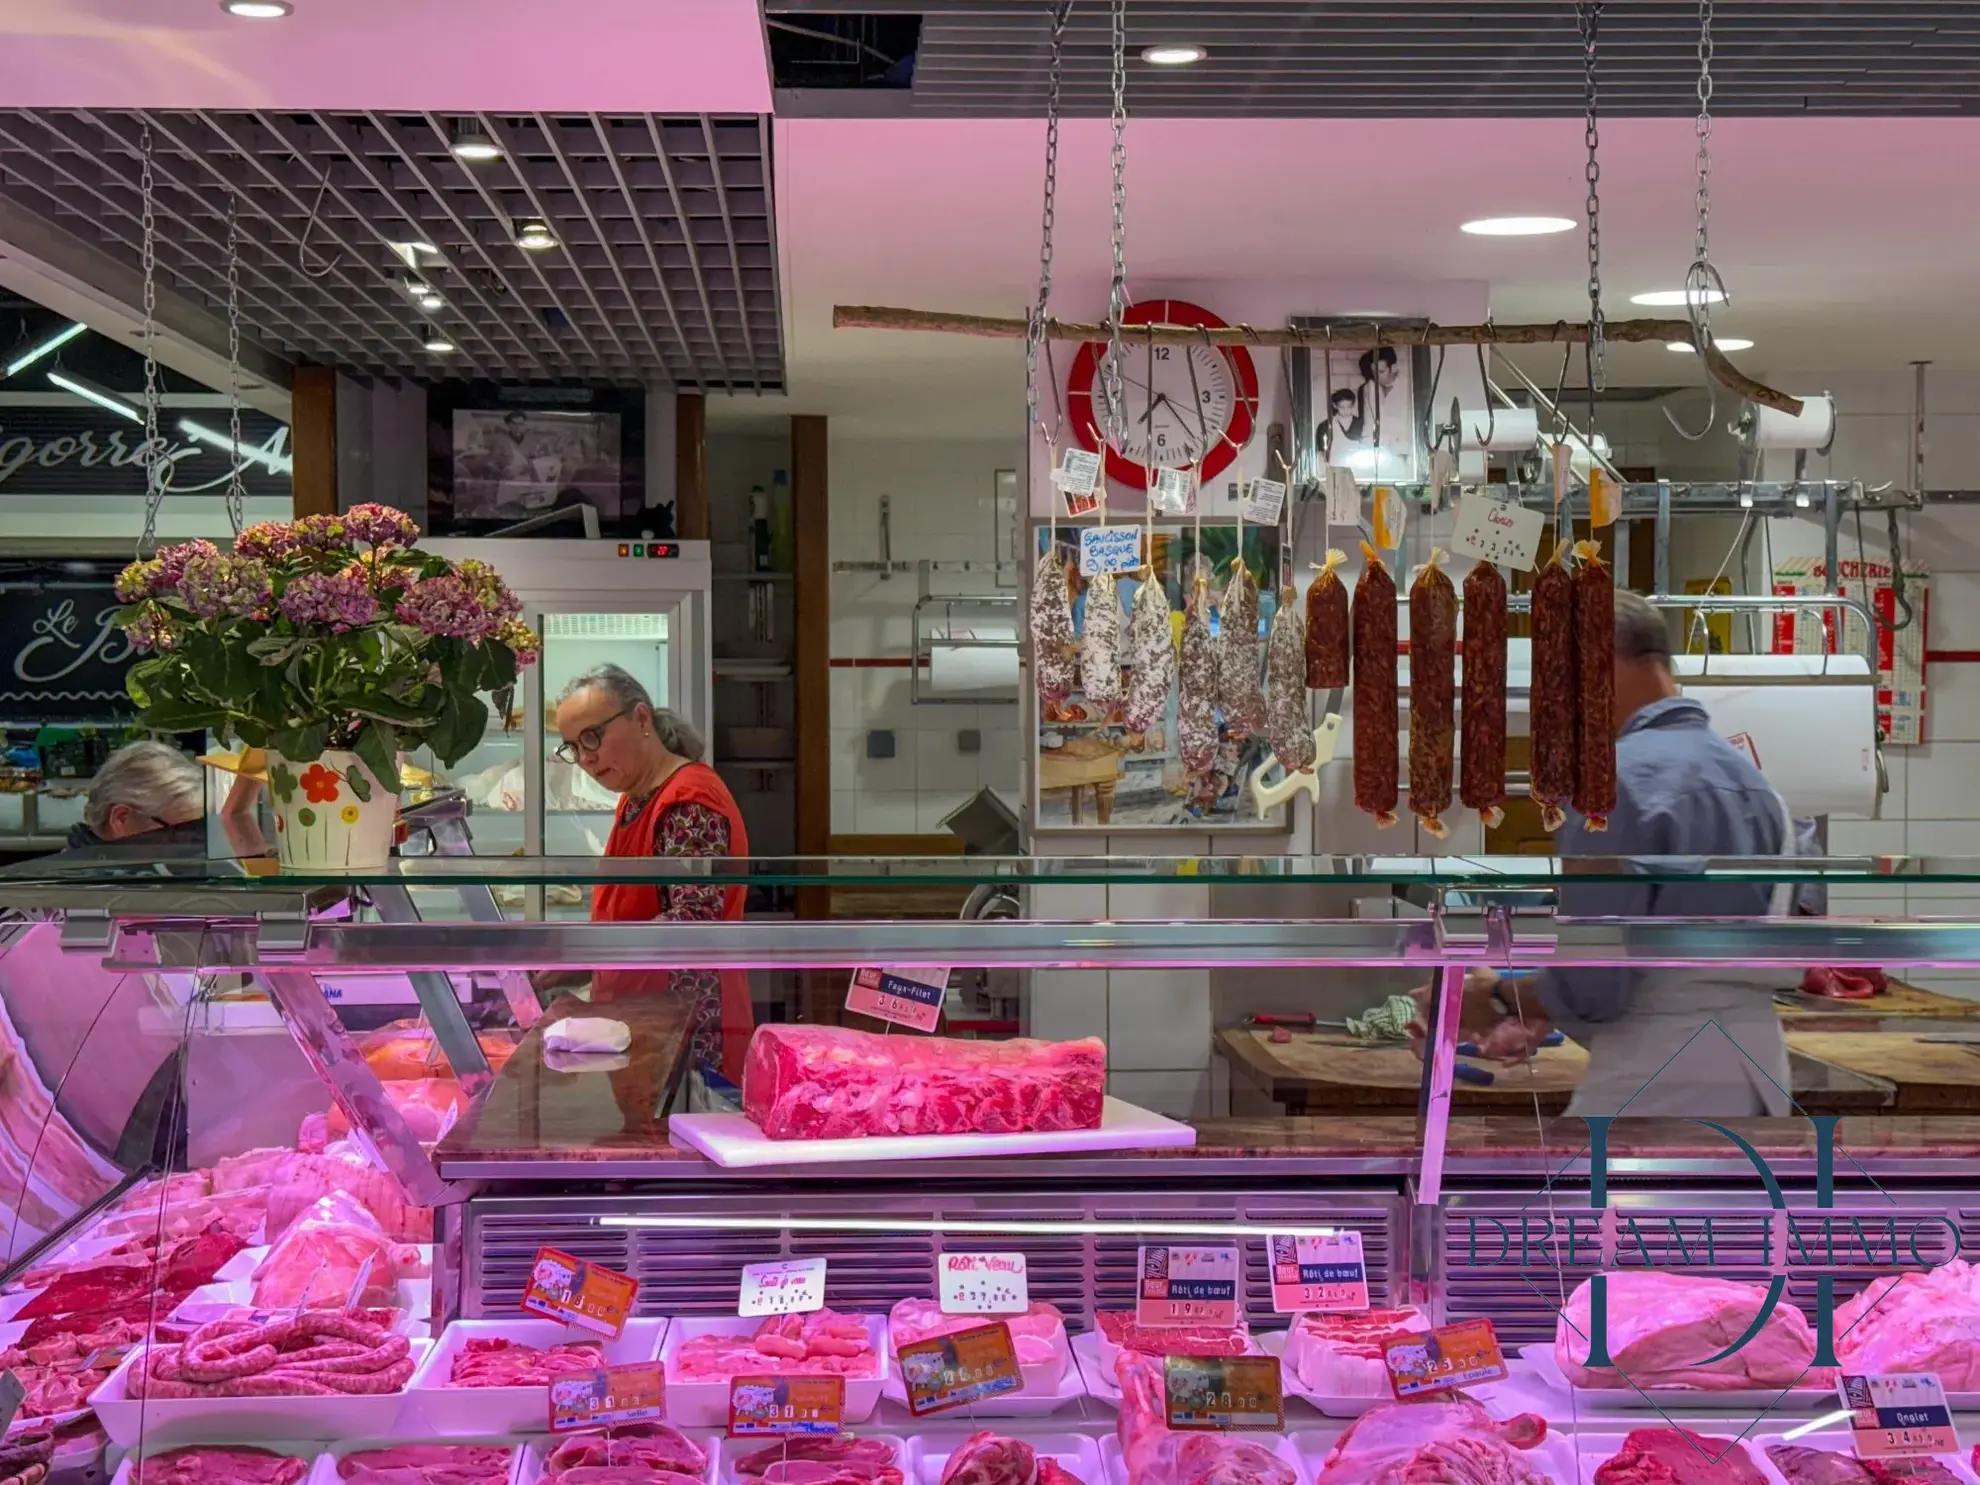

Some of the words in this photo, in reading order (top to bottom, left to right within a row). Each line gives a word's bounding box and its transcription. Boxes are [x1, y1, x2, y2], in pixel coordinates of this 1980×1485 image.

[1154, 347, 1170, 361] 12
[1202, 390, 1211, 404] 3
[1157, 433, 1166, 447] 6
[0, 428, 168, 482] gorre
[1813, 560, 1892, 578] BOCHERIE
